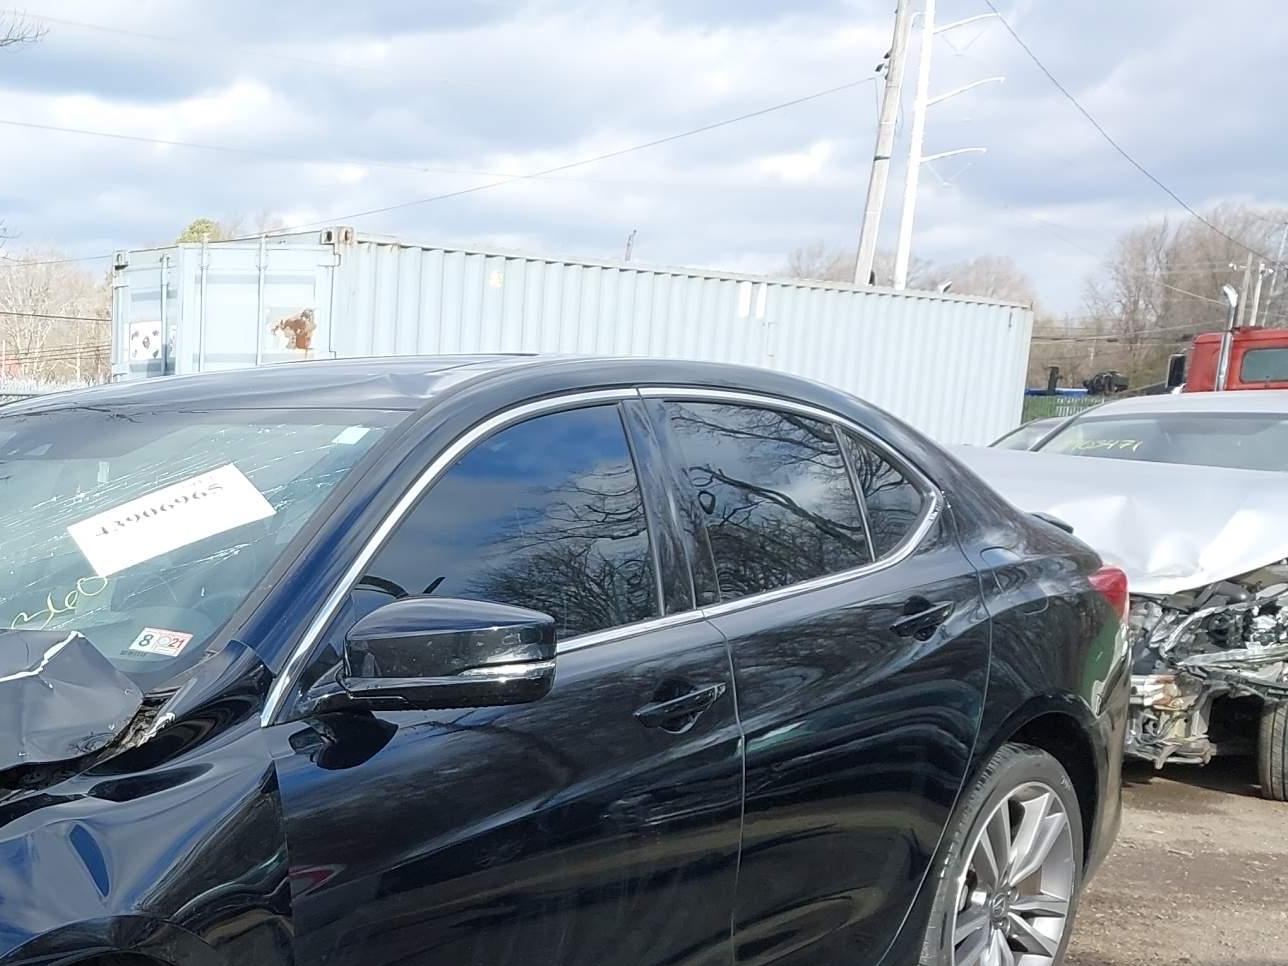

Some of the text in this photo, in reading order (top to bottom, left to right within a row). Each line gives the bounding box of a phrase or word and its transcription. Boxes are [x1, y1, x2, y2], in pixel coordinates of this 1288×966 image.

[95, 483, 224, 537] 43906965
[138, 634, 185, 649] 8 21
